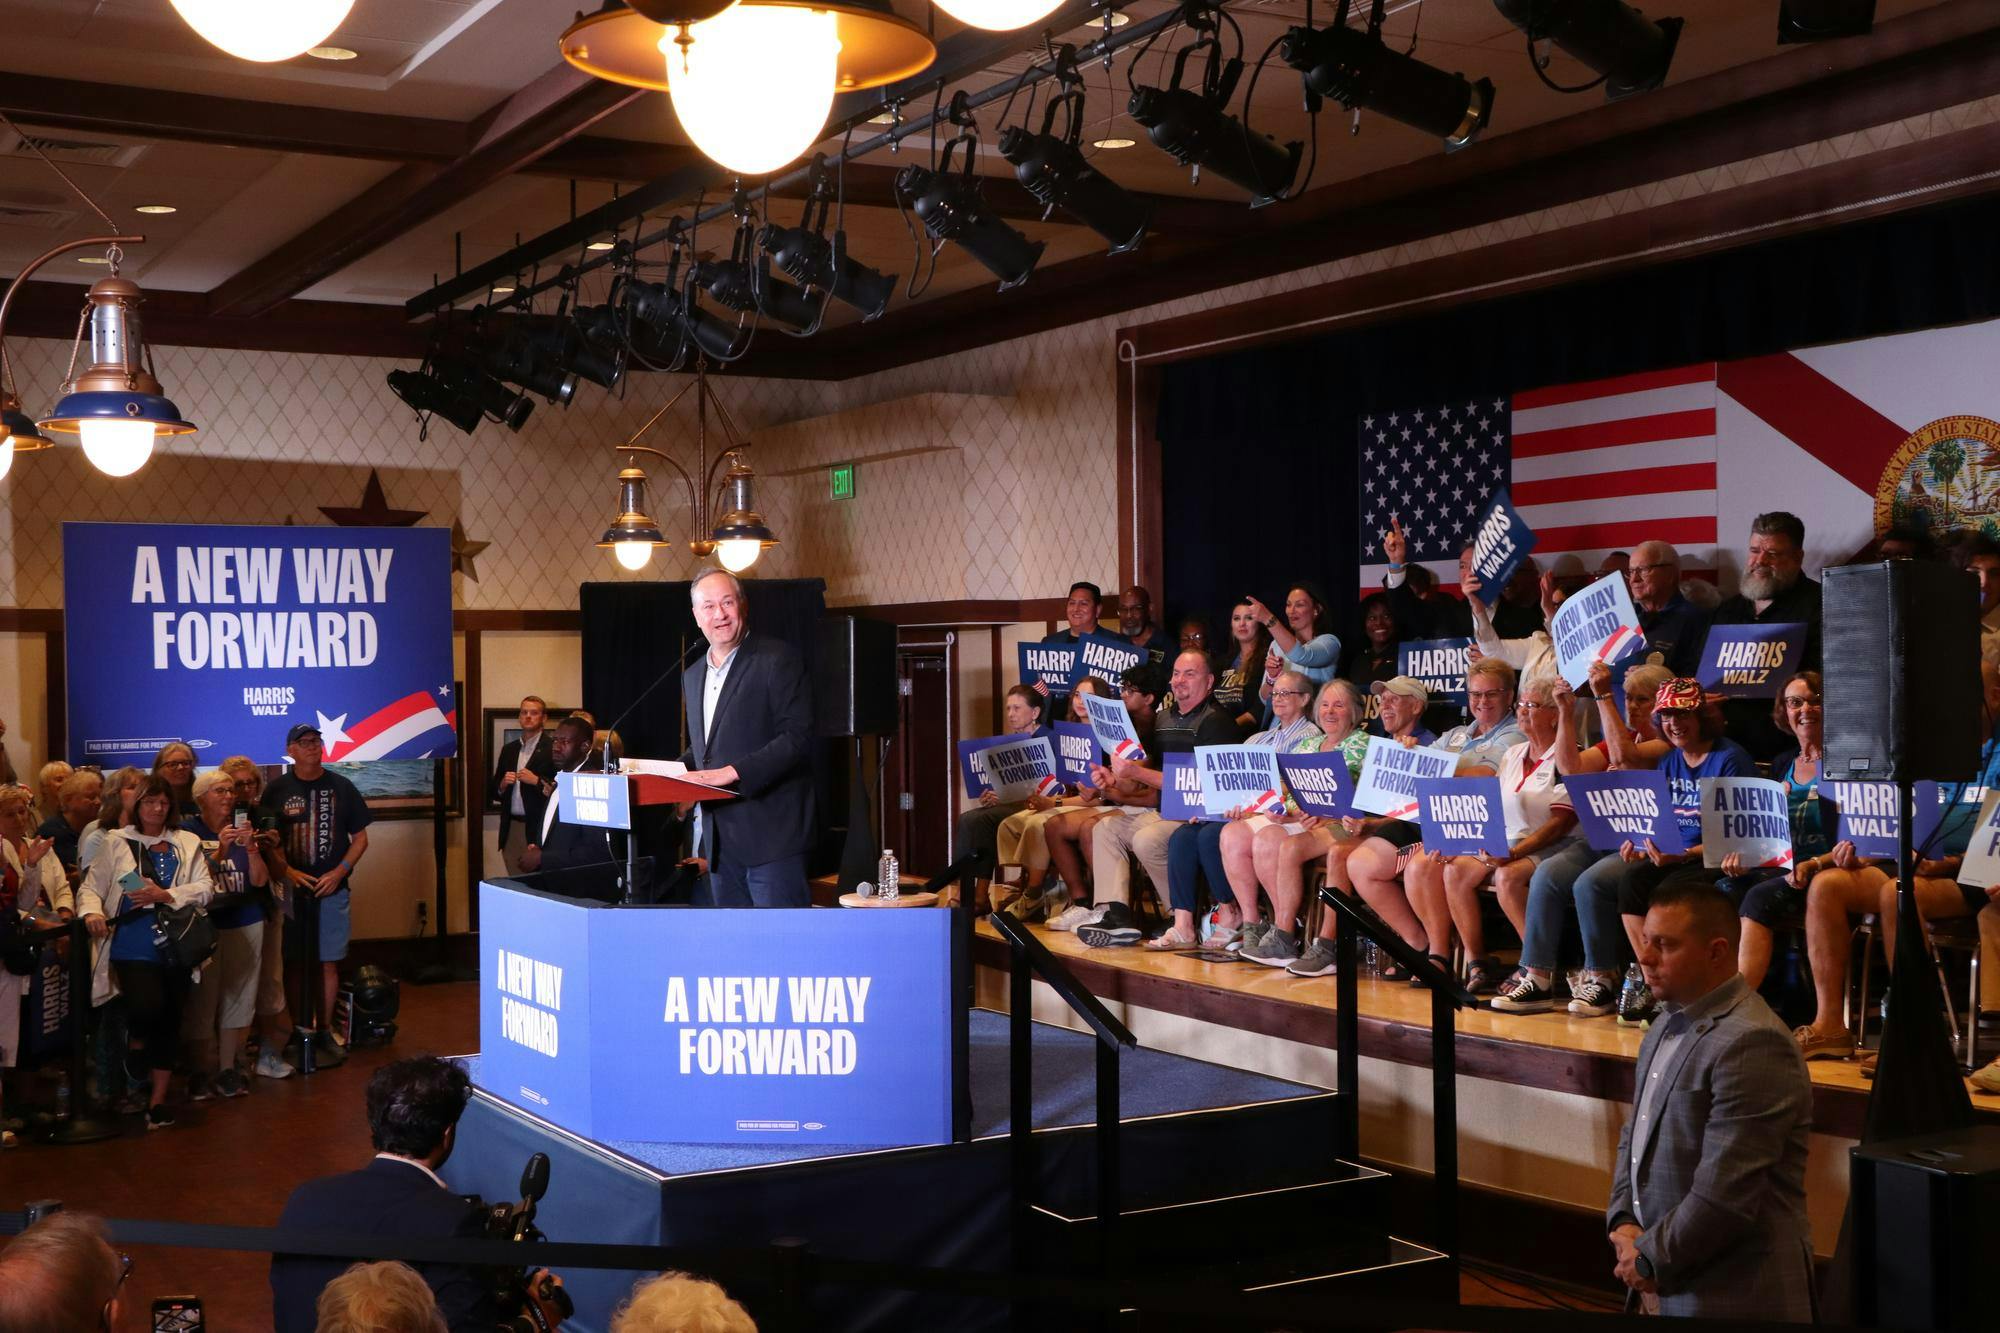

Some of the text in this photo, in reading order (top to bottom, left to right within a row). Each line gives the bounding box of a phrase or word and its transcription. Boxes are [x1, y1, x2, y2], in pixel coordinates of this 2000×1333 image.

[1906, 438, 1924, 455] OF
[1927, 422, 1960, 438] THE
[1963, 421, 2000, 442] STAT
[834, 469, 848, 495] EXIT
[1471, 504, 1511, 575] HARRIS
[1480, 535, 1516, 580] WALZ
[132, 546, 394, 603] A NEW WAY
[1555, 584, 1617, 645] A NEW WAY
[153, 612, 378, 669] FORWARD
[1560, 611, 1620, 665] FORWARD
[1026, 650, 1075, 672] HARRI
[1082, 642, 1139, 673] HARRIS
[1408, 647, 1471, 677] HARRIS
[1716, 641, 1787, 668] HARRIS
[1722, 669, 1770, 685] WALZ
[244, 687, 295, 705] HARRIS
[252, 705, 288, 716] WALZ
[1091, 700, 1106, 720] NEW
[1104, 705, 1124, 723] WAY
[988, 755, 998, 770] A
[996, 748, 1023, 767] NEW
[1022, 743, 1048, 761] WAY
[1060, 735, 1092, 760] HARRIS
[998, 762, 1051, 785] FORWARD
[1064, 759, 1086, 773] WALZ
[1206, 752, 1271, 771] A NEW WAY
[1373, 746, 1449, 778] A NEW WAY
[1214, 772, 1272, 792] FORWARD
[1285, 767, 1337, 792] HARRIS
[1372, 769, 1417, 797] FORWA
[576, 799, 609, 823] FORWARD
[1301, 791, 1335, 806] WALZ
[1429, 795, 1489, 823] HARRIS
[1586, 788, 1659, 818] HARRIS
[1714, 787, 1728, 811] A
[1733, 787, 1773, 811] NEW
[319, 789, 329, 860] DEMOCRACY
[1441, 823, 1485, 839] WALZ
[1608, 817, 1655, 835] WALZ
[497, 949, 562, 1011] A NEW WAY
[43, 964, 60, 1034] HARRIS
[664, 977, 871, 1022] A NEW WAY
[502, 996, 558, 1058] FORWARD
[679, 1028, 857, 1075] FORWARD
